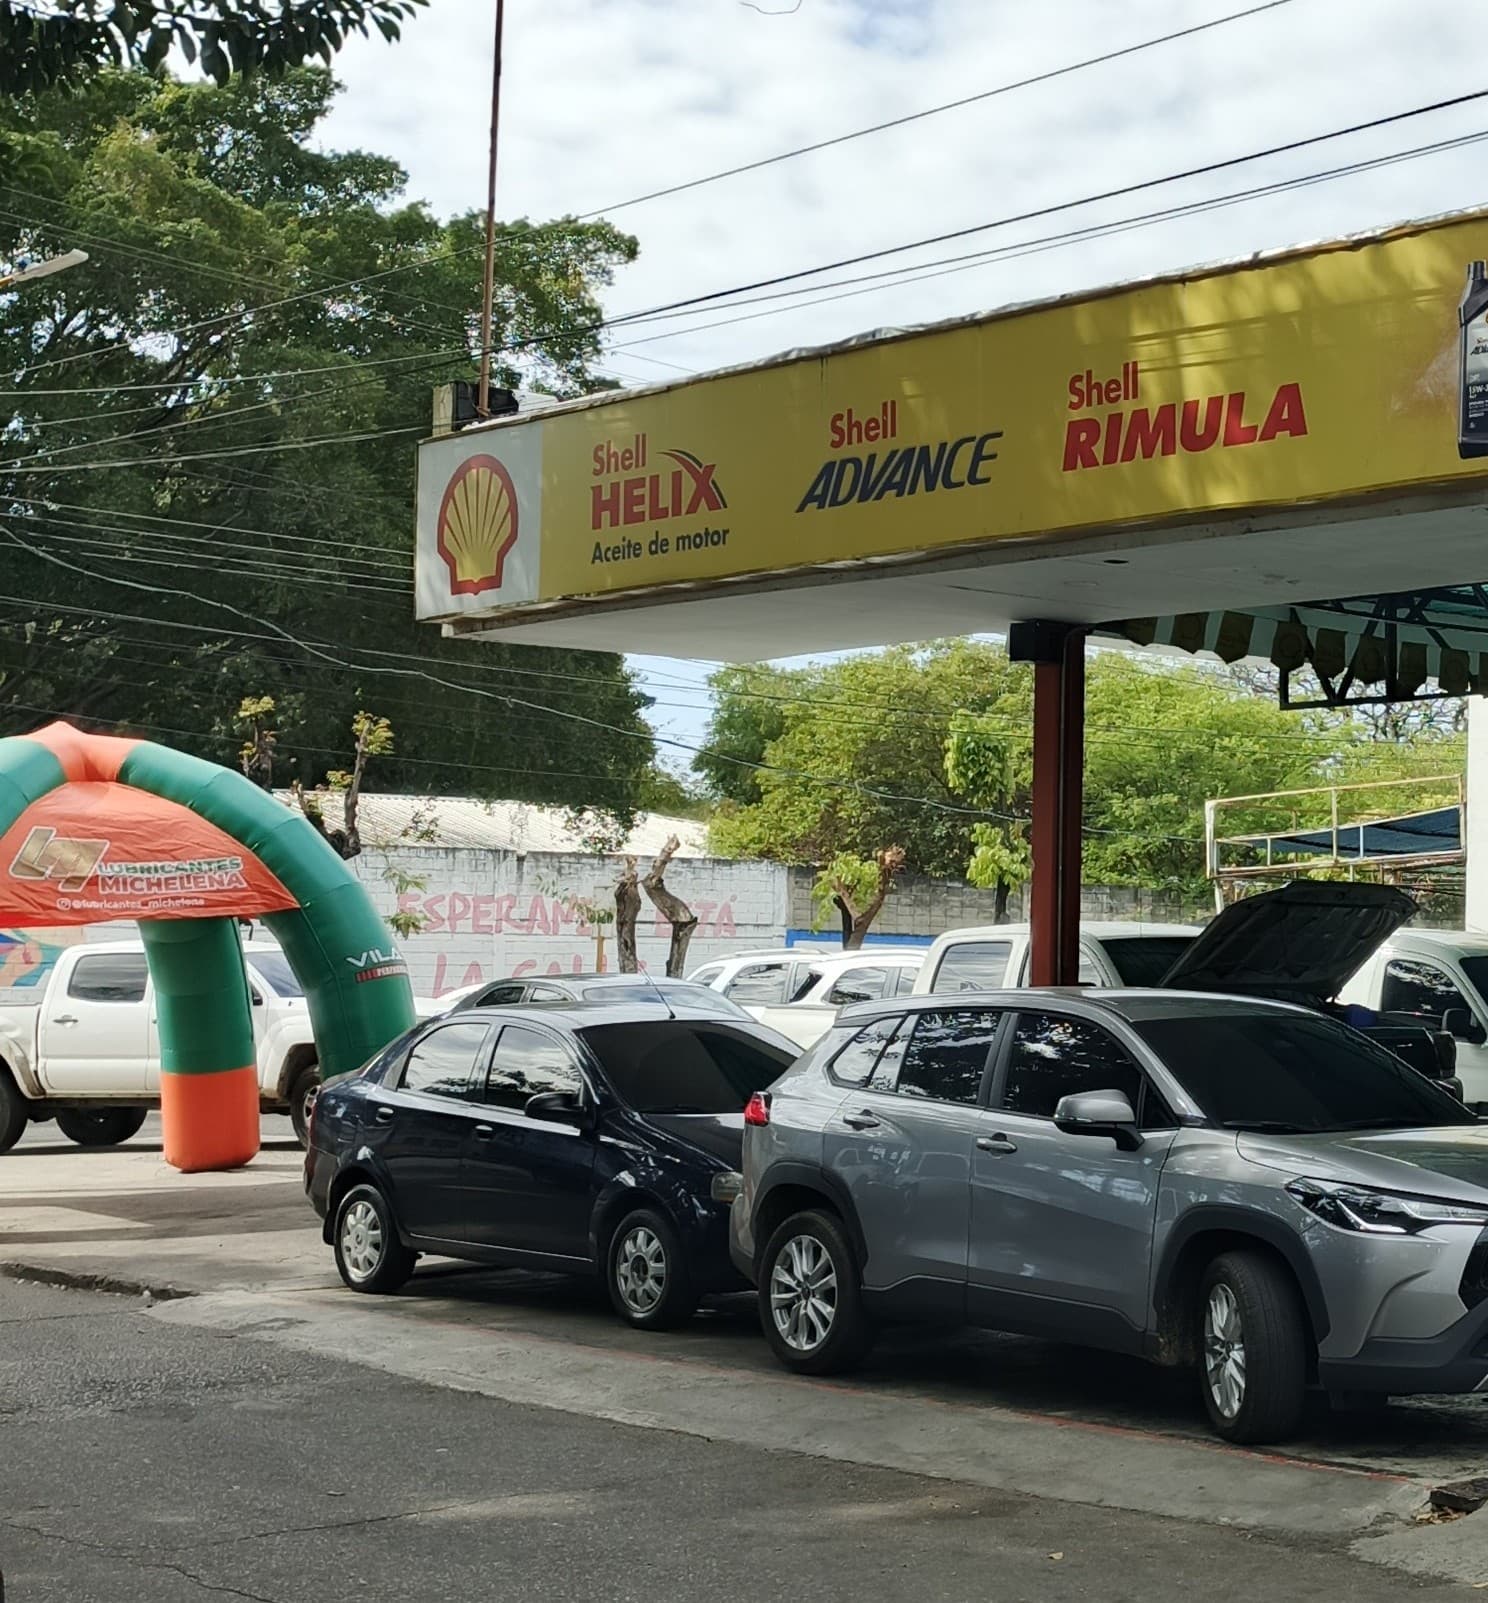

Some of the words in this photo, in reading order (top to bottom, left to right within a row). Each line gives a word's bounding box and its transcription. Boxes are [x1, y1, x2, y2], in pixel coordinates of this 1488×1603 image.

[1068, 361, 1138, 410] Shell
[830, 400, 897, 448] Shell
[1062, 383, 1308, 472] RIMULA
[592, 434, 647, 476] Shell
[796, 432, 1003, 513] ADVANCE
[591, 452, 727, 530] HELIX
[591, 536, 642, 564] Aceite
[649, 532, 670, 556] de
[675, 526, 730, 552] motor
[97, 857, 242, 876] LUBRICANTES
[99, 872, 247, 894] MICHELENA
